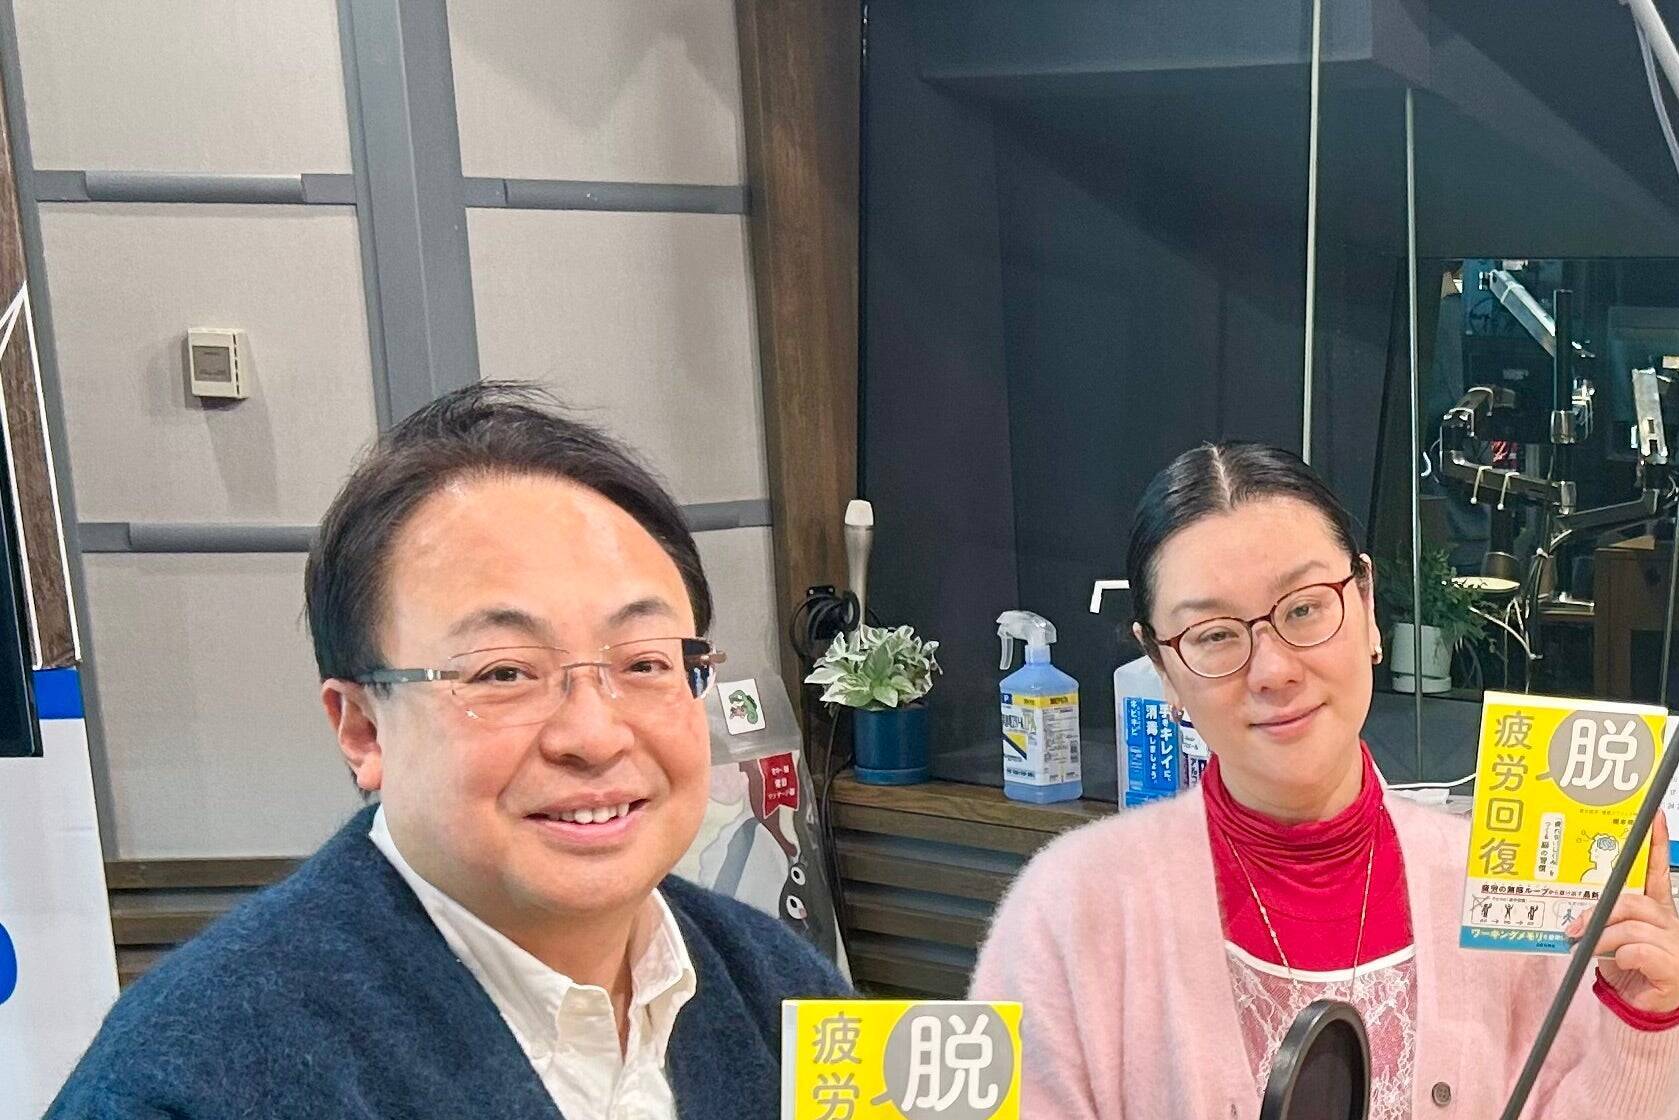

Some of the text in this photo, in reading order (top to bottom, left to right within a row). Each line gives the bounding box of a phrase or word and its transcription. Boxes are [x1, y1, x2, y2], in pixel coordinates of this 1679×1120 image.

[1478, 710, 1534, 876] 疲労回復
[1560, 718, 1639, 792] 脱
[900, 1014, 999, 1113] 脱
